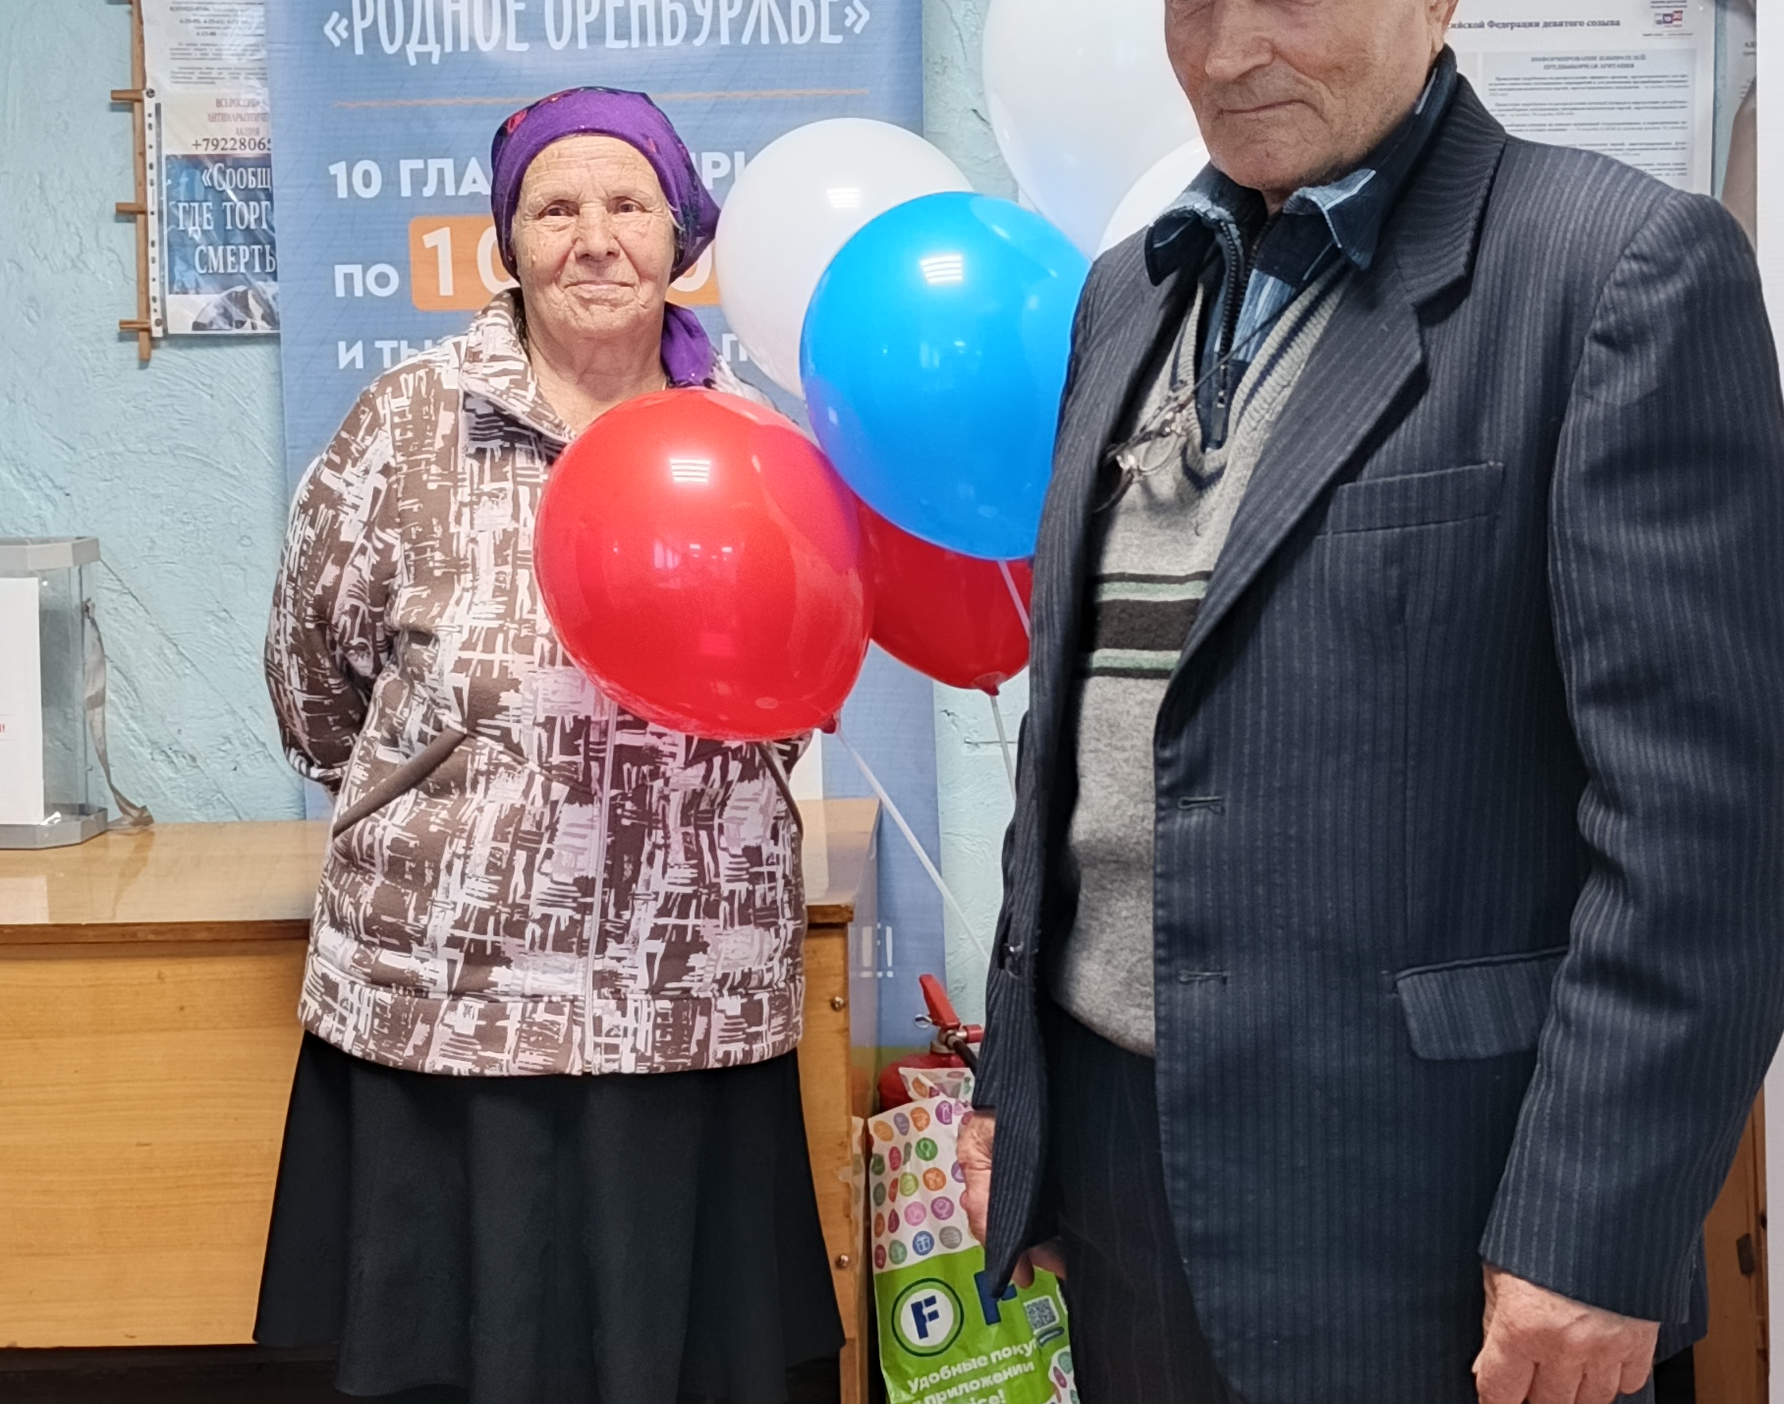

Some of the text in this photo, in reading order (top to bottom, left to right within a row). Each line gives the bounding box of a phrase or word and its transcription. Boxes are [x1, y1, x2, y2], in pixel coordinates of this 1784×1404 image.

[1487, 19, 1540, 31] Федерации
[1542, 19, 1584, 30] девятого
[1586, 18, 1621, 28] созыва
[328, 159, 383, 199] 10
[177, 200, 214, 237] ГДЕ
[334, 263, 400, 298] ПО
[337, 340, 364, 370] И
[910, 1295, 940, 1340] F
[906, 1353, 989, 1394] Удобные
